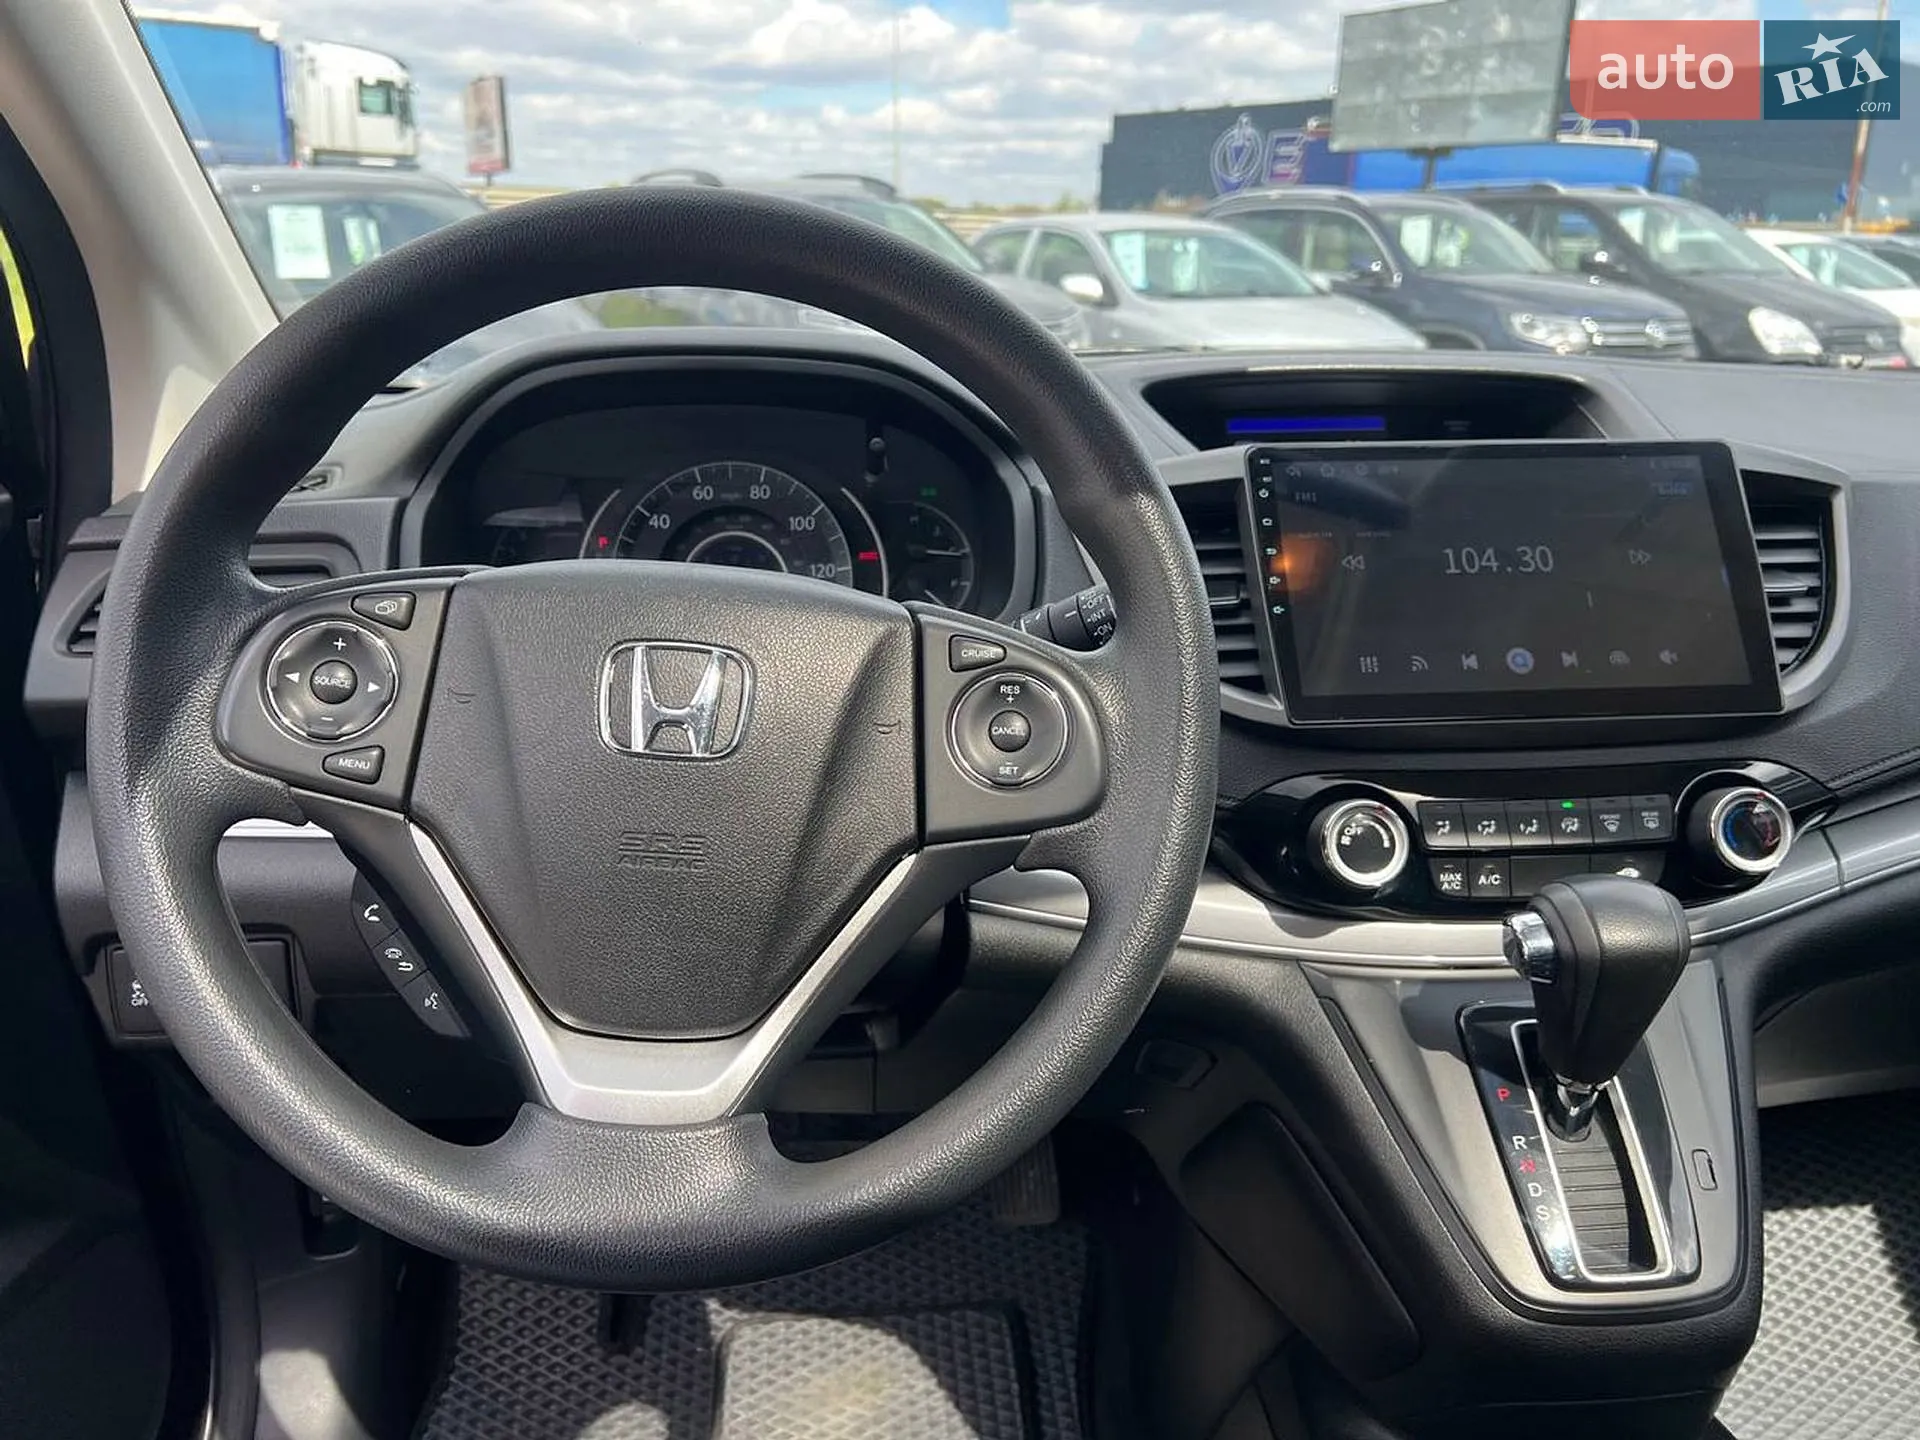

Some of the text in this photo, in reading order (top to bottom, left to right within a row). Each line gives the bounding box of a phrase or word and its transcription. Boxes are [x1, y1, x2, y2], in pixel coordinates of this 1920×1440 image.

[692, 485, 714, 501] 60
[749, 484, 771, 500] 80
[648, 513, 671, 530] 40
[788, 515, 816, 531] 100
[1442, 545, 1554, 575] 104.30
[810, 562, 836, 579] 120
[961, 648, 996, 660] CRUISE
[313, 674, 351, 689] SOURCE
[1000, 684, 1020, 695] RES
[992, 725, 1025, 737] CANCEL
[338, 757, 370, 771] MENU
[999, 766, 1018, 776] SET
[1440, 872, 1462, 882] MAX
[1478, 873, 1501, 886] A/C
[1441, 881, 1462, 891] A/C
[1496, 1087, 1511, 1102] P
[1512, 1135, 1527, 1150] R
[1527, 1182, 1543, 1198] D
[1535, 1205, 1550, 1221] S
